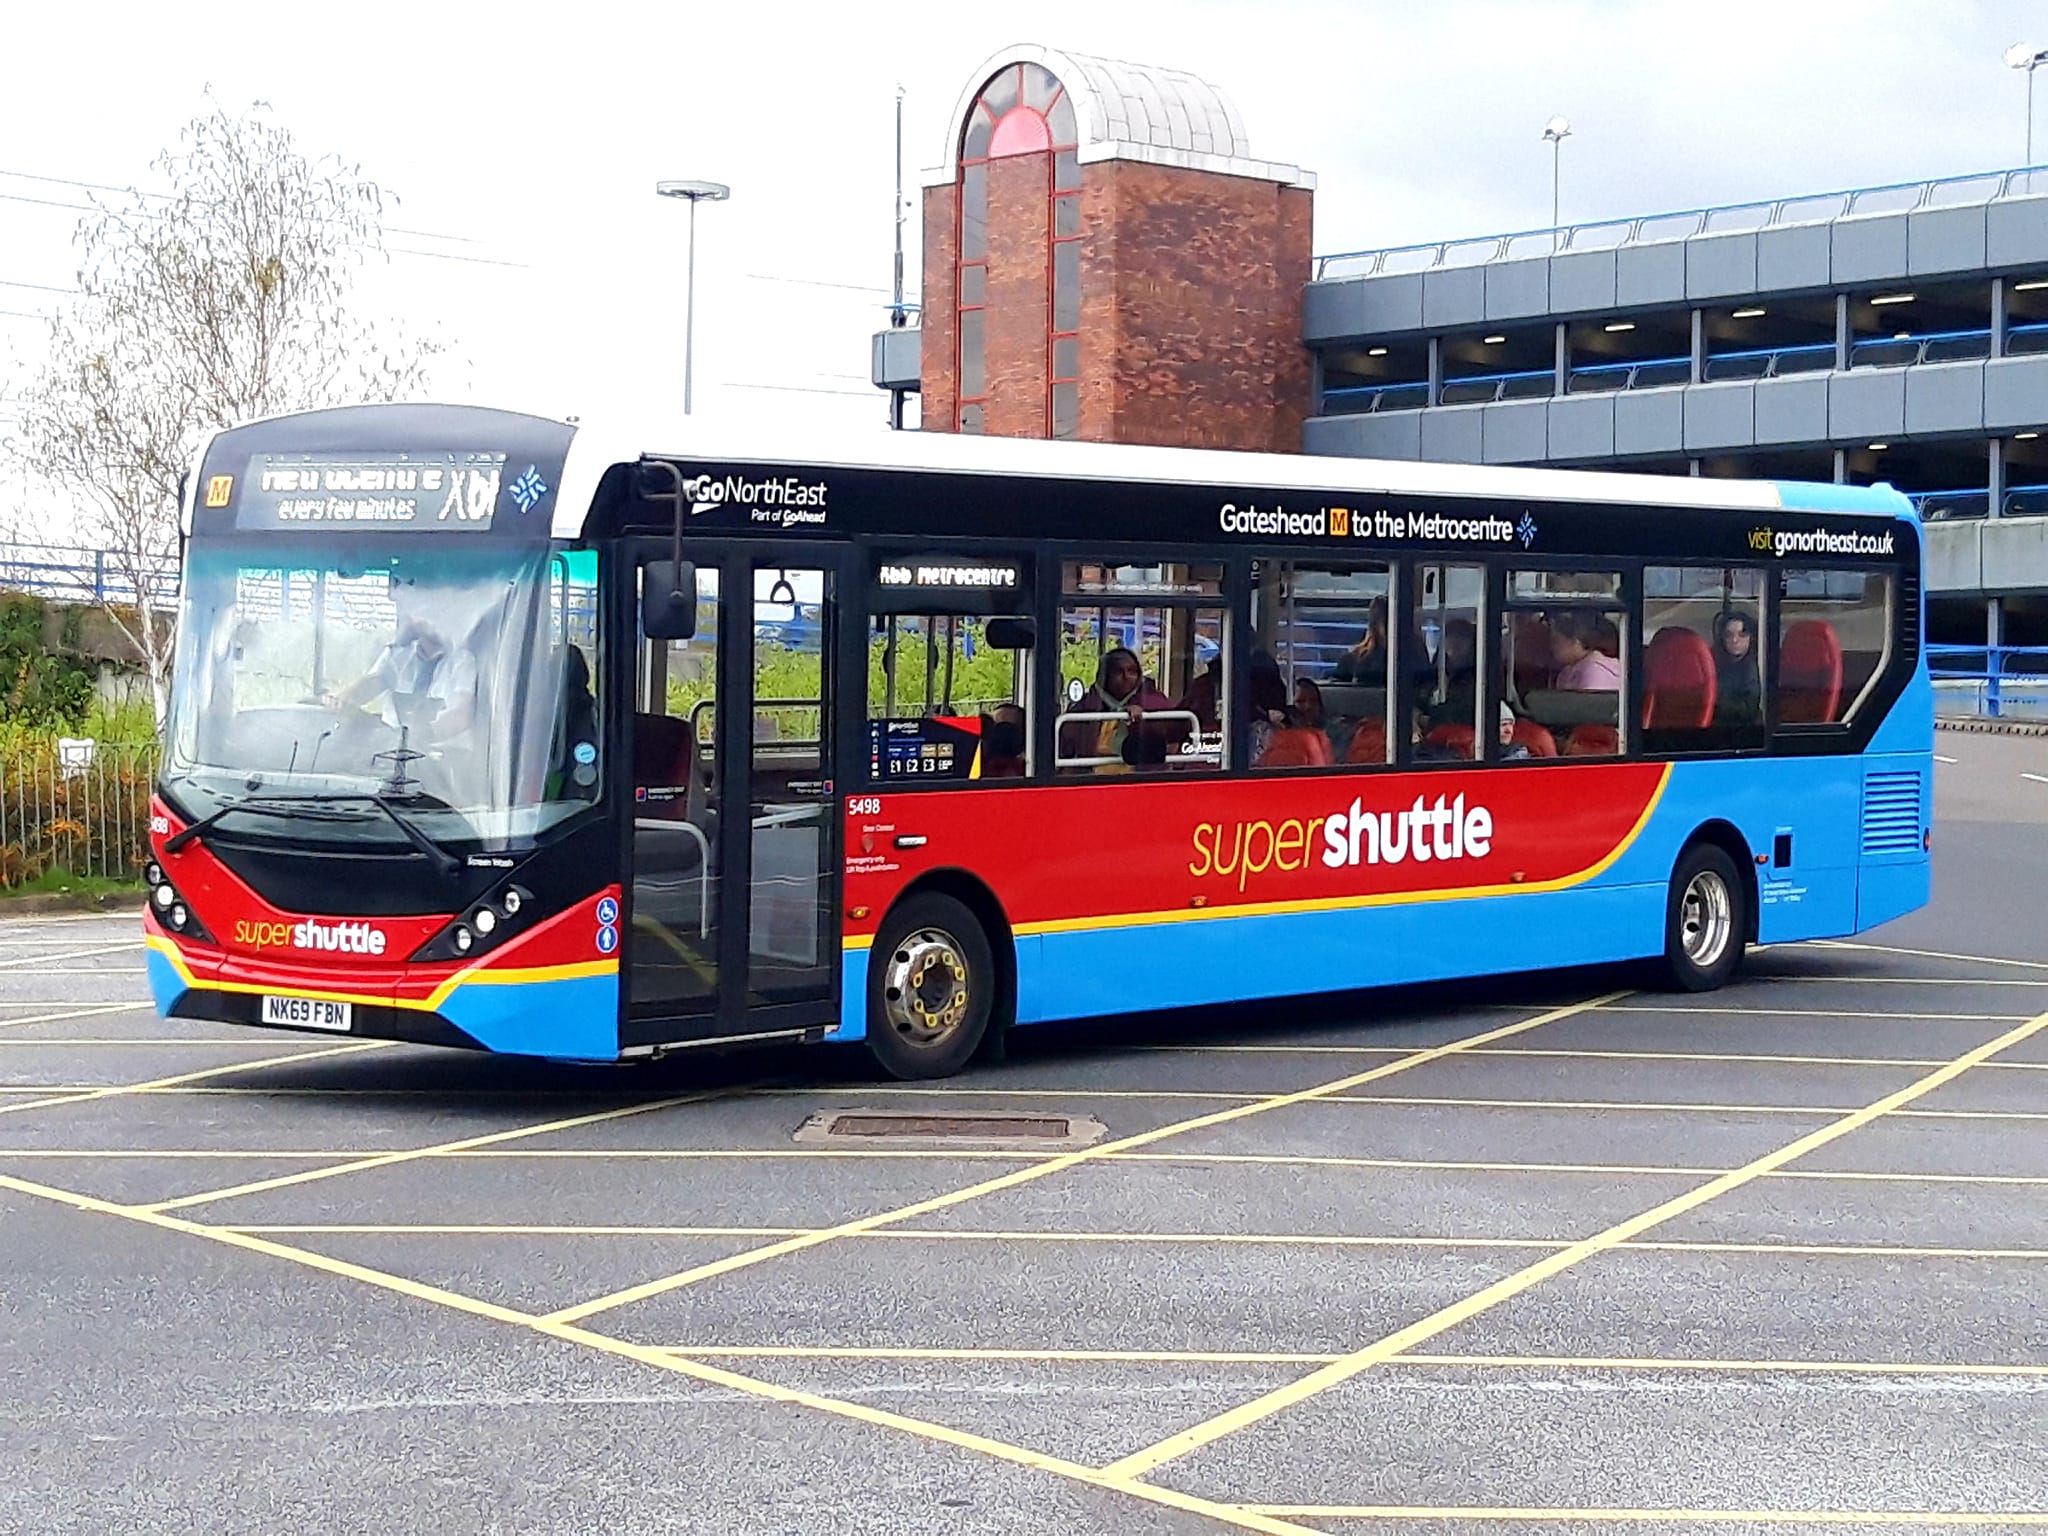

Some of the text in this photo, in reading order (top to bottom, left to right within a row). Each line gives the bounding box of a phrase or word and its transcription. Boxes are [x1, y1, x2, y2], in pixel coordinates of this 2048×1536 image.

[209, 479, 231, 504] M
[278, 498, 325, 520] every
[326, 497, 353, 520] few
[751, 508, 770, 521] Part
[771, 510, 782, 522] of
[1220, 504, 1513, 540] Gateshead M to the Metrocentre
[1748, 527, 1894, 556] visit gonortheast.co.uk
[890, 760, 901, 773] £1
[906, 759, 918, 773] £2
[923, 759, 935, 772] £3
[848, 798, 881, 816] 5498
[269, 998, 344, 1025] NK69 FBN
